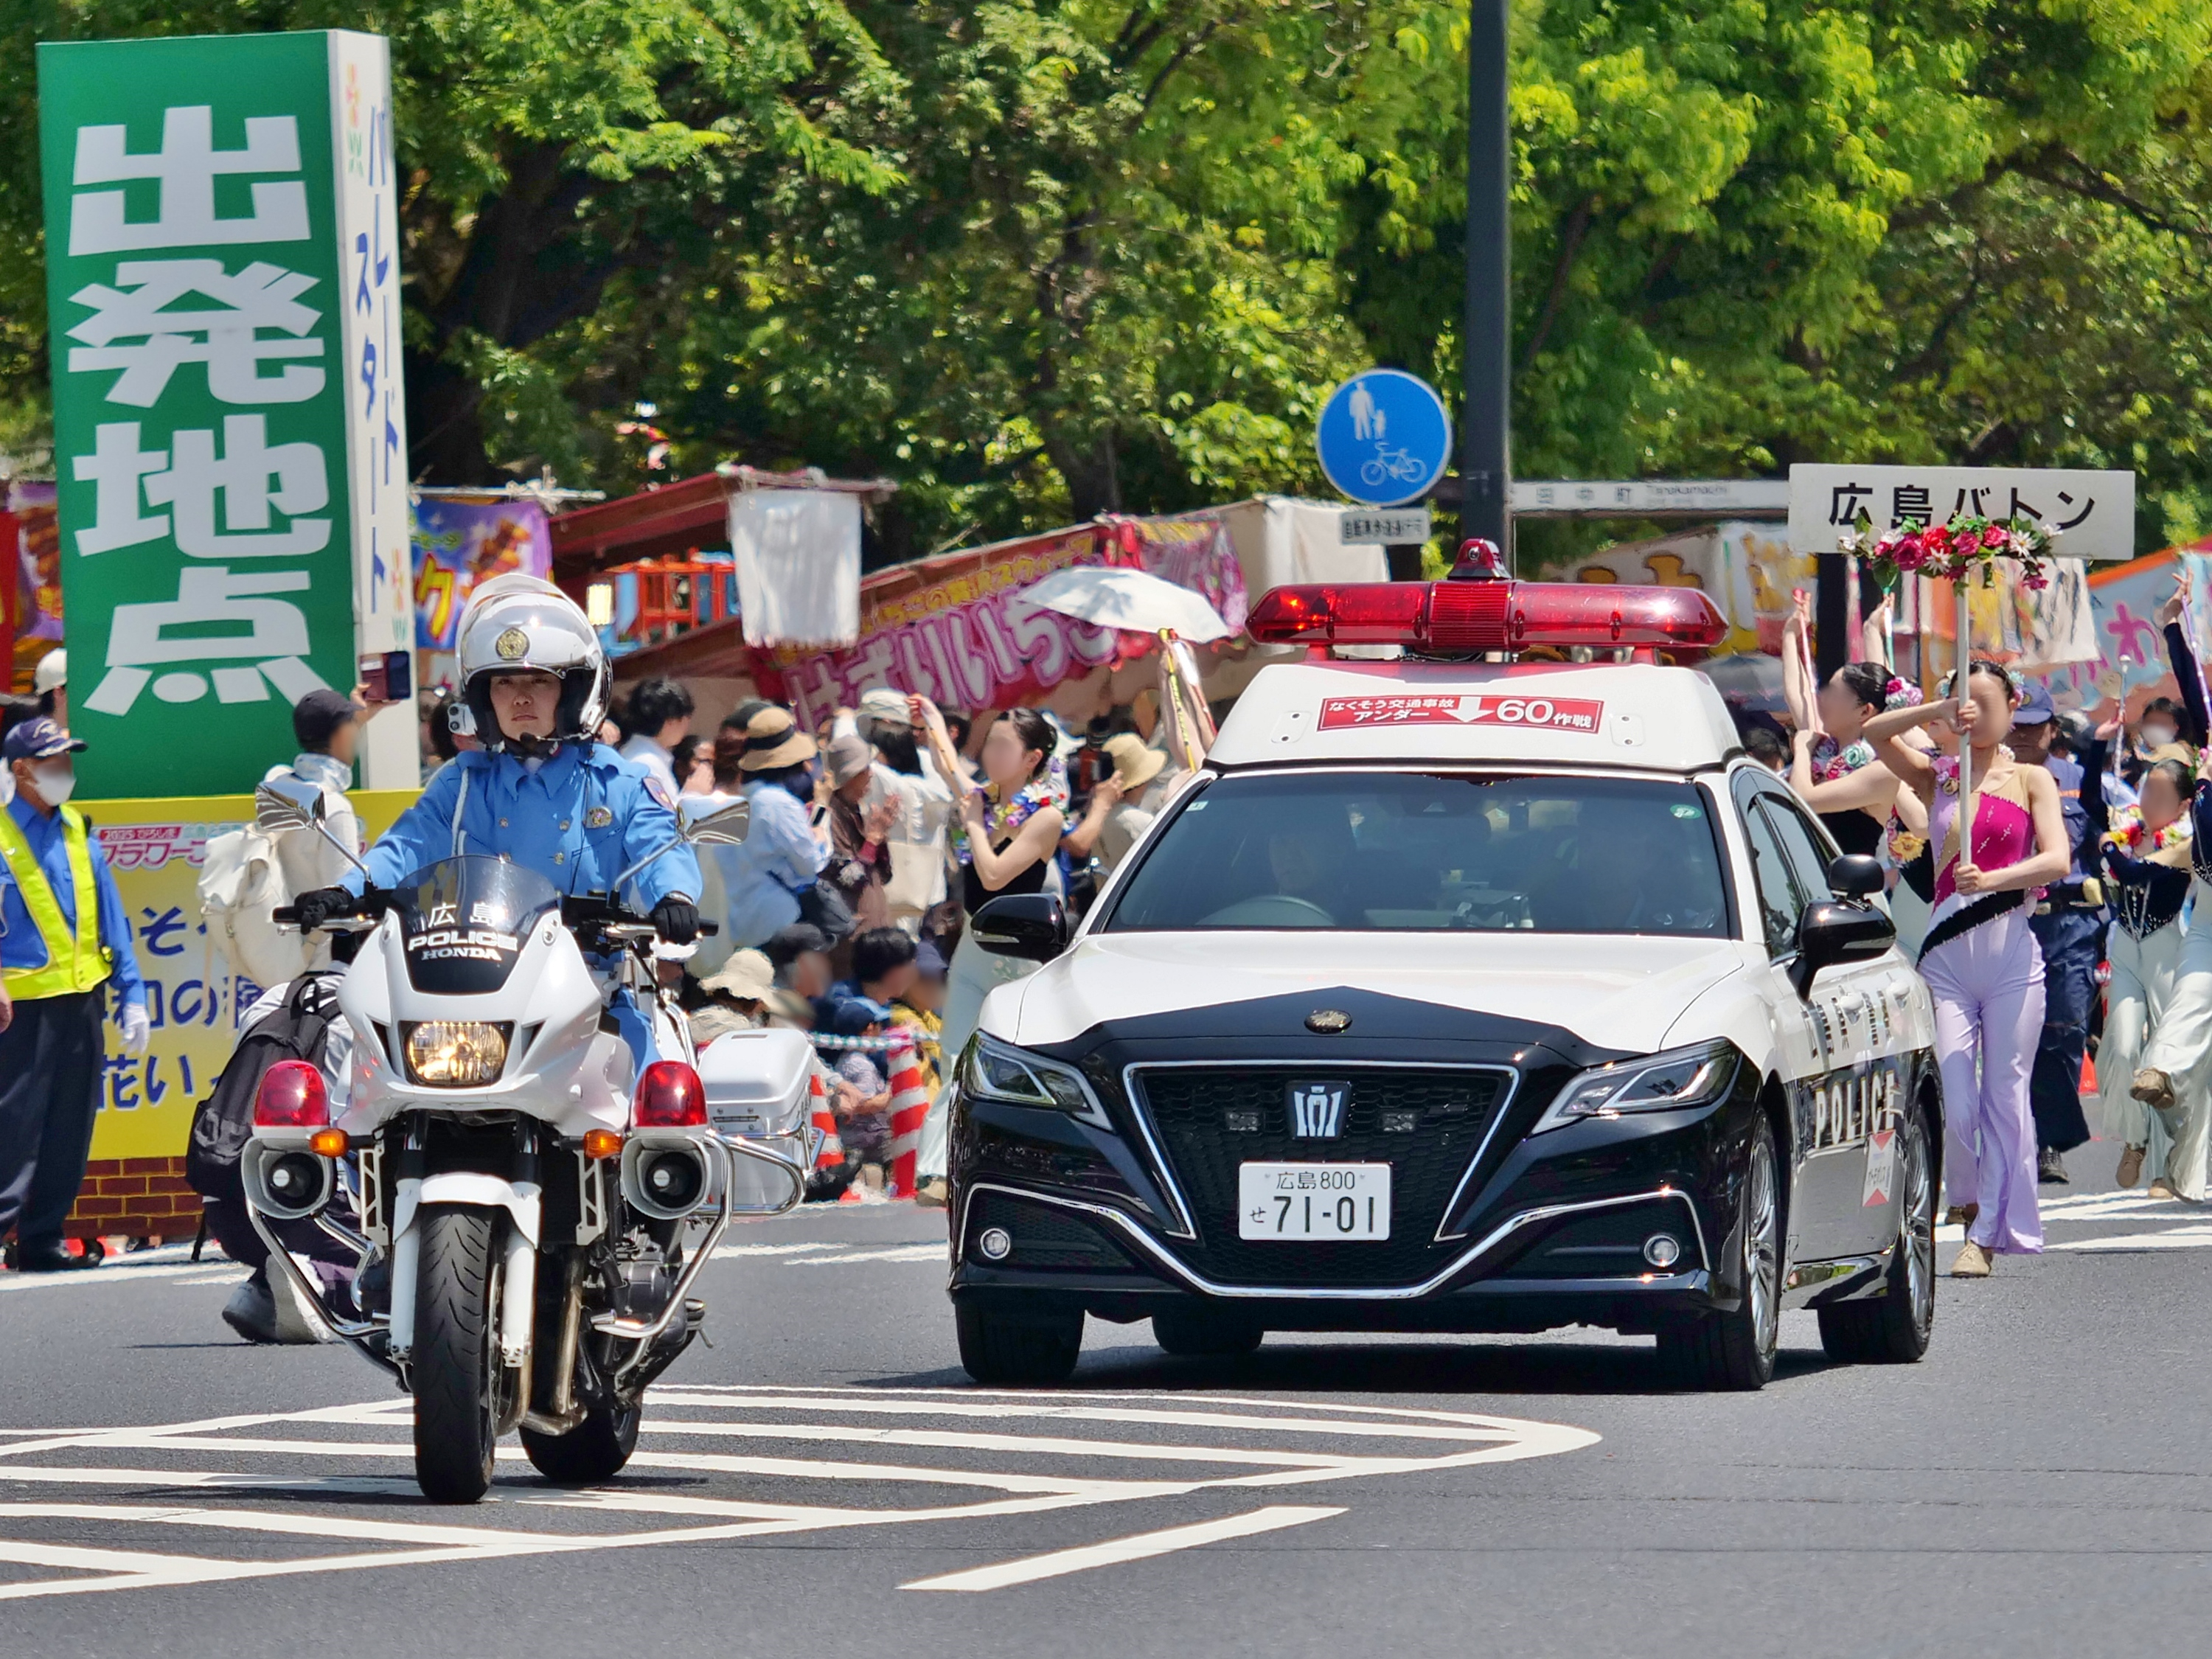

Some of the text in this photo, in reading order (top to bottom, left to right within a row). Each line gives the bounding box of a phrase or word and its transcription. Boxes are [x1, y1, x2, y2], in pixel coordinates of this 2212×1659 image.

[66, 105, 333, 717] 出発地点
[355, 231, 386, 614] スタート
[1828, 481, 2096, 530] 広島バトン
[1329, 698, 1455, 712] なくそう交通事故
[1353, 709, 1430, 723] アンダー
[408, 930, 518, 952] POLICE
[421, 947, 502, 961] HONDA
[1814, 1070, 1897, 1150] POLICE
[1249, 1195, 1374, 1234] せ 71-01
